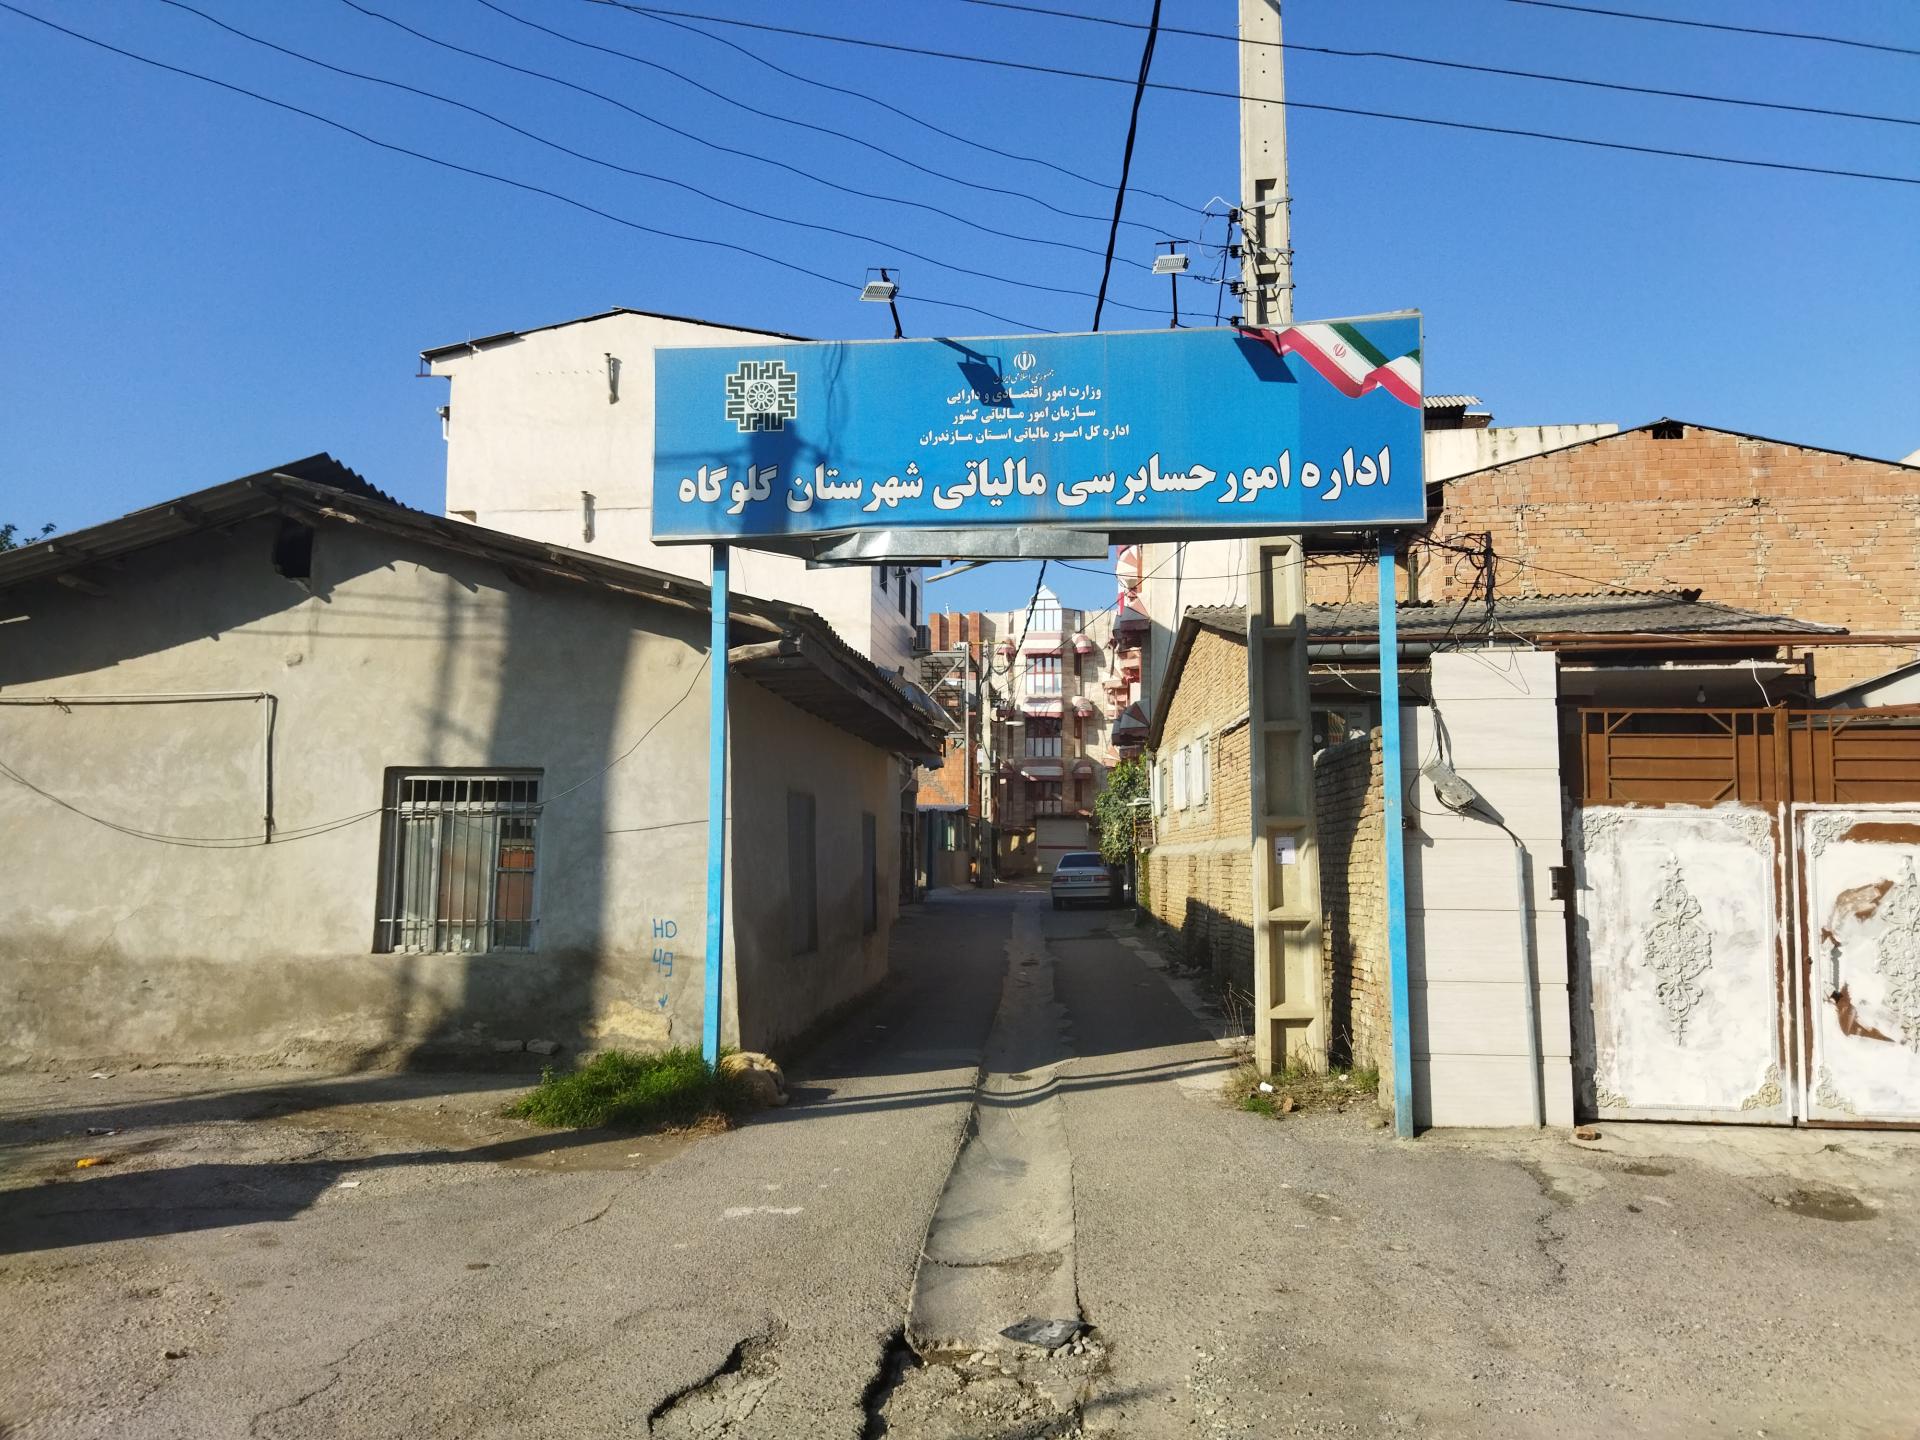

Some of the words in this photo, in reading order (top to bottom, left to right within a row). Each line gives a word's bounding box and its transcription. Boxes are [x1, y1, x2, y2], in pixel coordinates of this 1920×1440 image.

[947, 389, 980, 405] دارایی
[992, 386, 1043, 403] اقتصادی
[1045, 385, 1067, 401] امور
[1069, 385, 1101, 400] وزارت
[952, 409, 979, 425] کشور
[980, 408, 1024, 424] مالیاتی
[1027, 409, 1049, 423] امور
[1051, 405, 1096, 421] سازمان
[920, 430, 973, 446] مازندران
[975, 428, 1012, 444] استان
[1014, 427, 1050, 443] مالیاتی
[1052, 427, 1083, 442] امور
[1085, 425, 1100, 440] کل
[1102, 424, 1130, 438] اداره
[1056, 452, 1217, 506] حسابرسی
[1217, 449, 1290, 503] امور
[1301, 445, 1390, 501] اداره
[678, 464, 778, 515] گلوگاه
[786, 461, 923, 514] شهرستان
[932, 457, 1047, 509] مالیاتی
[652, 918, 678, 938] HD
